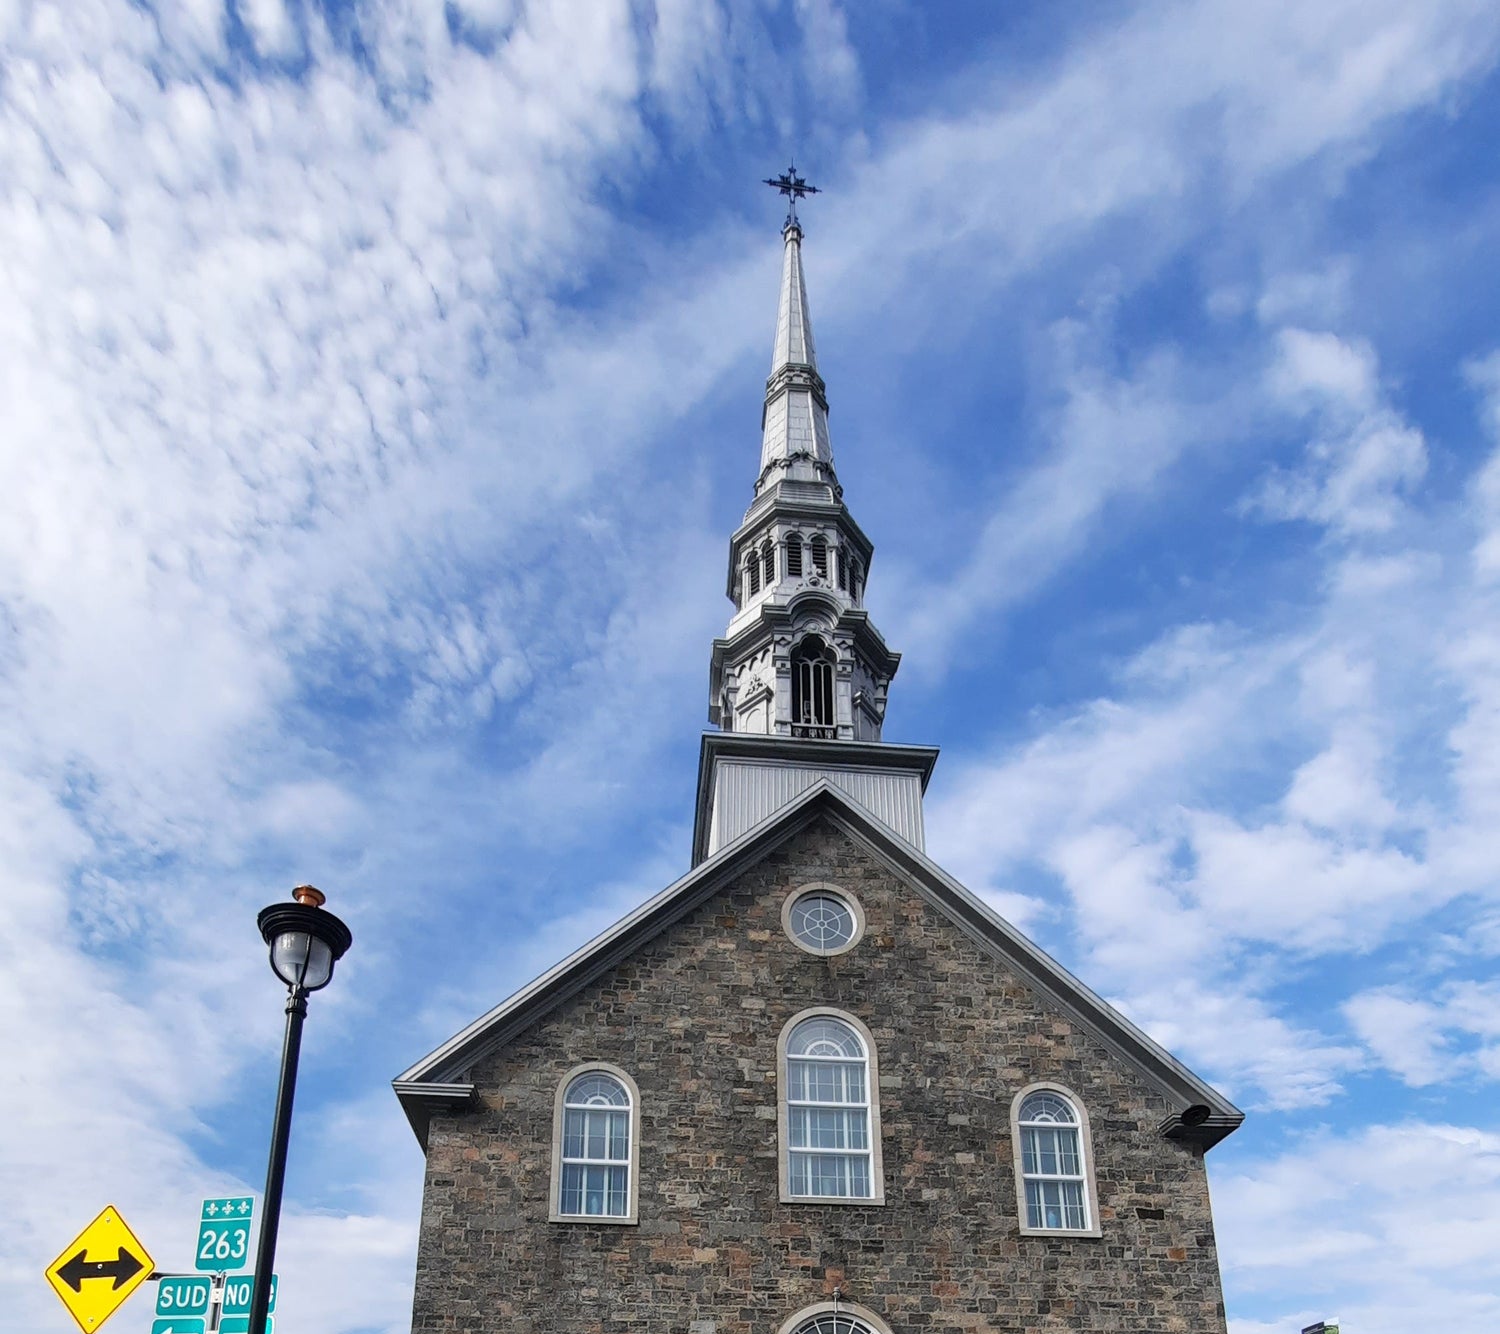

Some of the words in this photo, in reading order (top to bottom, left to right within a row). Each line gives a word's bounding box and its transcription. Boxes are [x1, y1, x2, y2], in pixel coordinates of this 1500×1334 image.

[199, 1229, 246, 1260] 263
[160, 1285, 207, 1308] SUD
[226, 1283, 274, 1306] NO
